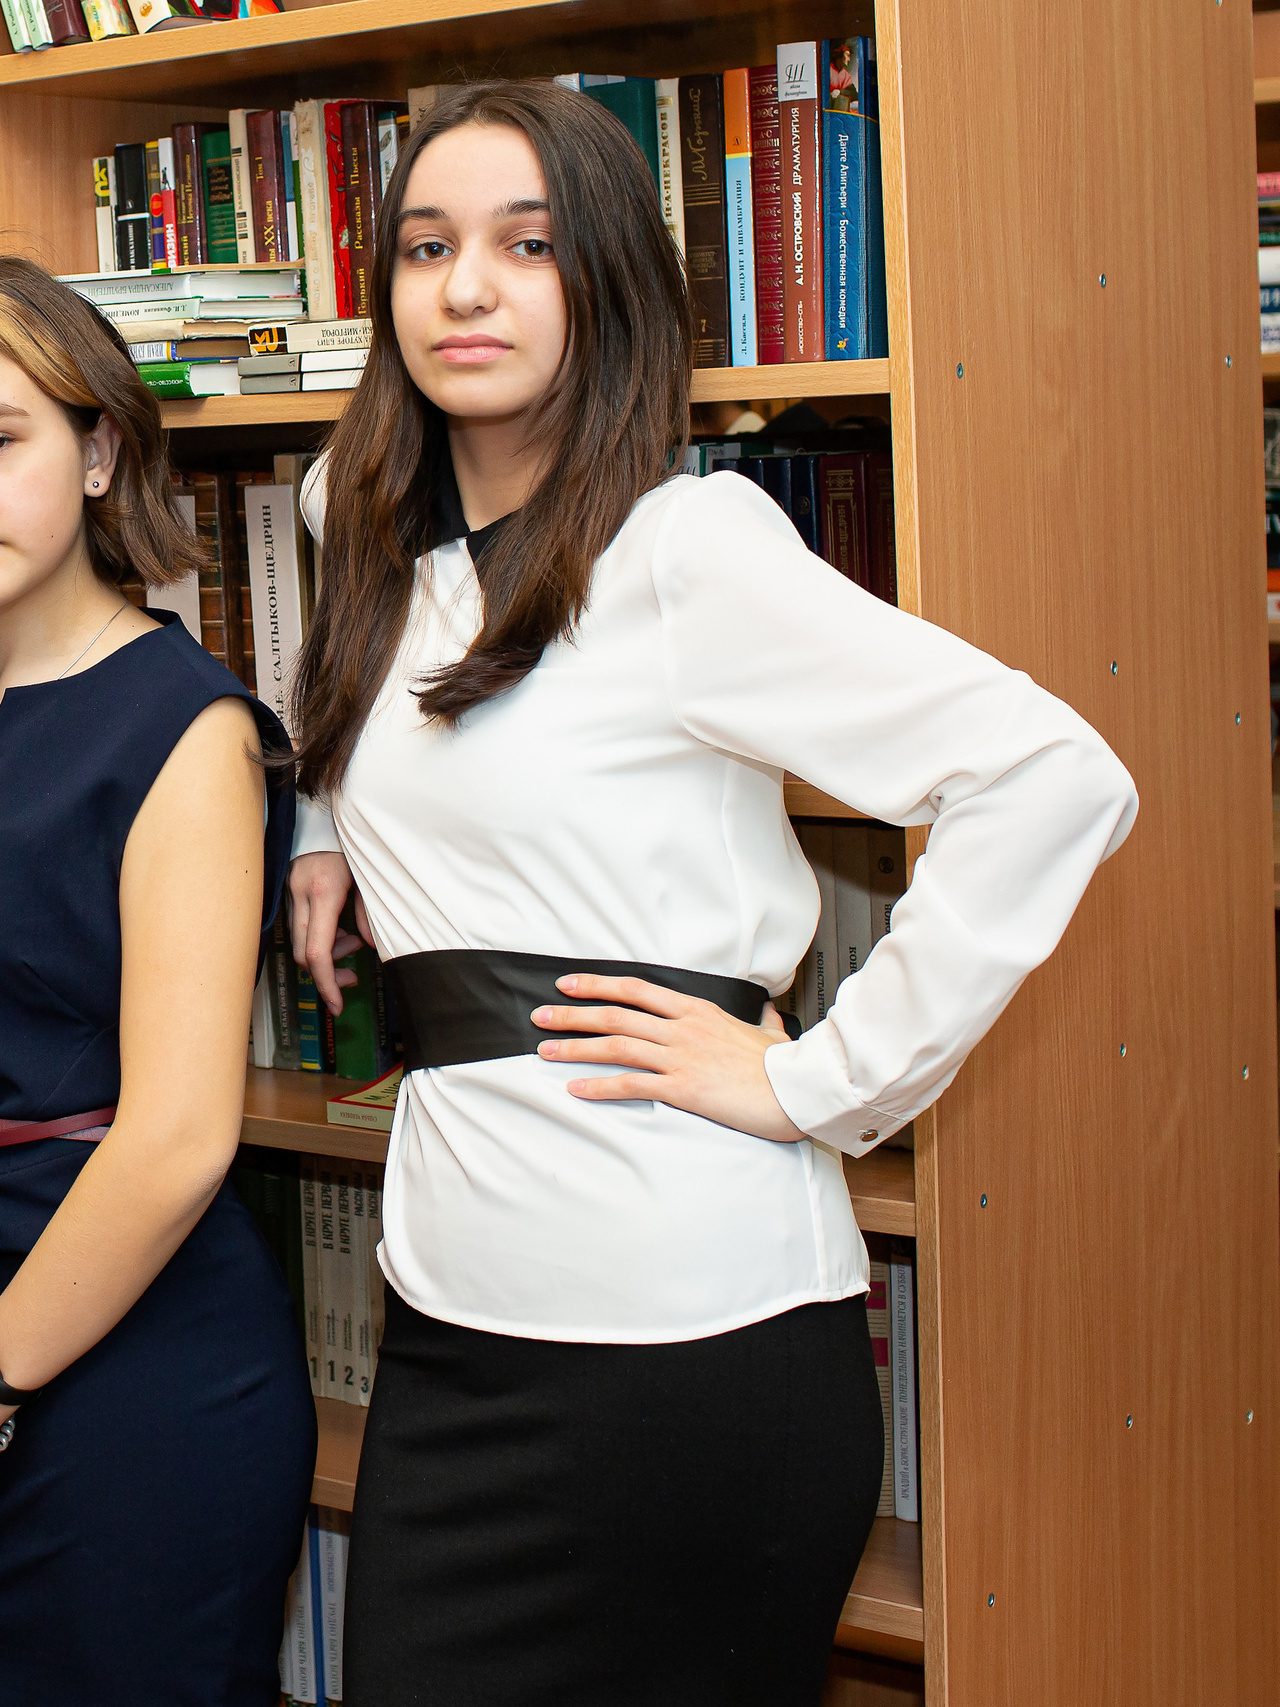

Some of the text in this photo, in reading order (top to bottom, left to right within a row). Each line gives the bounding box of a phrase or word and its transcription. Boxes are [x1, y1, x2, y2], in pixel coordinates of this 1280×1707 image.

[791, 107, 802, 186] ДРАМАТУРГИЯ
[265, 200, 273, 223] века
[349, 147, 368, 315] Горький Рассказы Пьесы
[735, 179, 746, 302] КОНДУИТ И ШВАМБРАНИЯ
[792, 192, 803, 262] ОСТРОВСКИЙ
[838, 134, 849, 329] Данте Алигьери Божественная комедия
[87, 282, 174, 298] АЛЕКСАНДРА БРУШТЕЙН
[337, 336, 363, 344] ХУТОРЕ
[739, 313, 747, 345] Кассиль
[261, 504, 282, 682] САЛТЫКОВ-ЩЕДРИН
[340, 1112, 361, 1121] ЧЕЛОВЕКА
[304, 1209, 316, 1238] КРУГЕ
[321, 1211, 333, 1241] КРУГЕ
[338, 1216, 350, 1245] КРУГЕ
[305, 1239, 317, 1247] В
[339, 1246, 350, 1254] В
[897, 1301, 907, 1348] НАЧИНАЕТСЯ
[310, 1357, 317, 1378] 1
[328, 1360, 335, 1382] 1
[344, 1365, 354, 1386] 2
[898, 1349, 908, 1403] ПОНЕДЕЛЬНИК
[361, 1376, 369, 1393] 3
[298, 1641, 307, 1664] БЫТЬ
[298, 1666, 308, 1697] БОГОМ
[330, 1664, 340, 1695] БОГОМ
